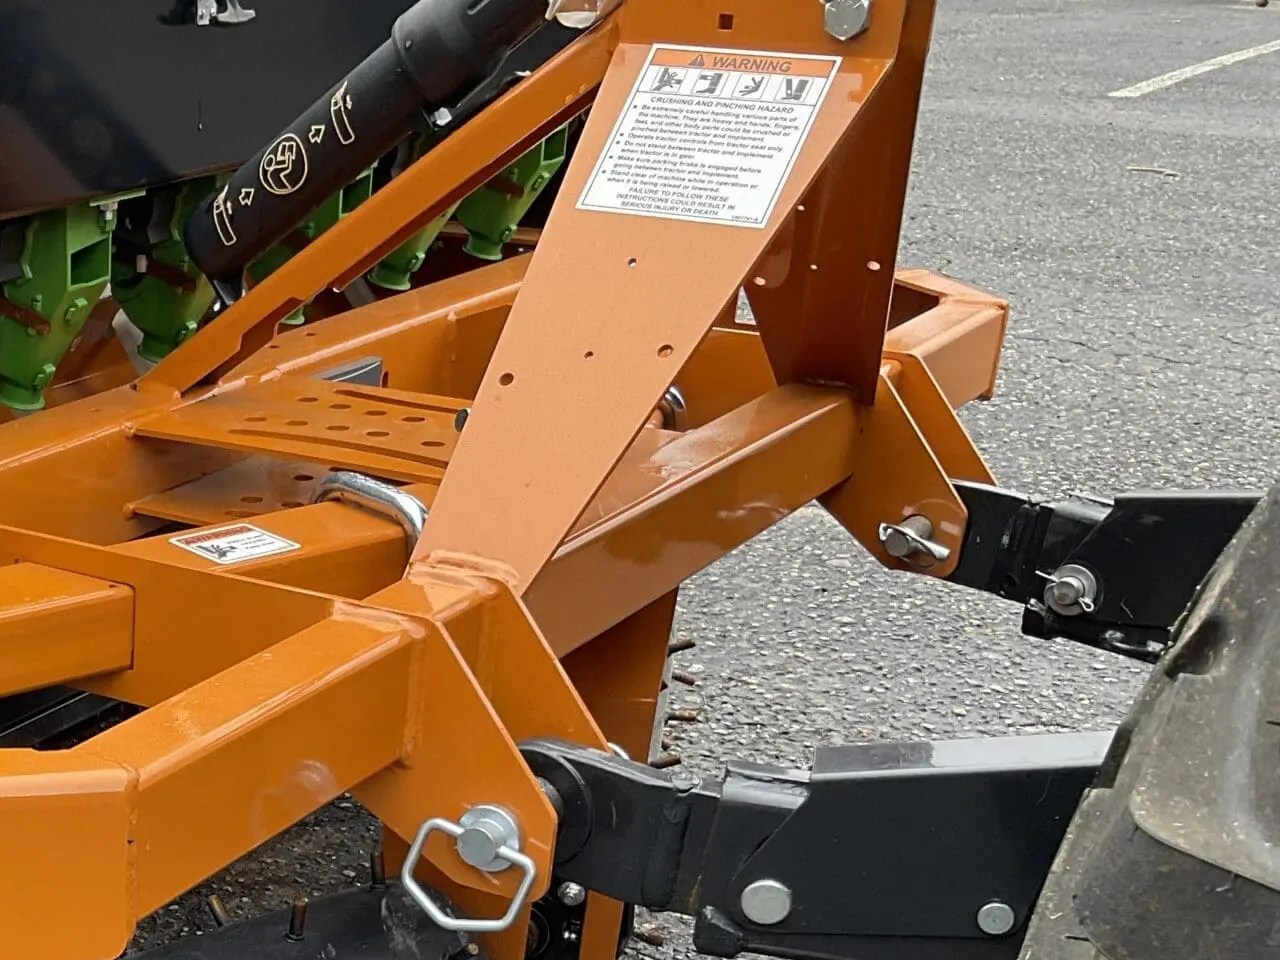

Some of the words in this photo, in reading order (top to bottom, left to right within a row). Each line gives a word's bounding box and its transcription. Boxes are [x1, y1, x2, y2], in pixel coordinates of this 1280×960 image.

[711, 56, 793, 72] WARNING
[651, 96, 694, 105] CRUSHING
[715, 102, 756, 110] PINCHING
[757, 105, 794, 114] HAZARD
[616, 193, 669, 203] INSTRUCTIONS
[697, 201, 726, 209] RESULT
[628, 187, 660, 195] FAILURE
[672, 191, 704, 199] FOLLOW
[620, 201, 653, 209] SERIOUS
[653, 204, 679, 212] INJURY
[693, 208, 718, 216] DEATH
